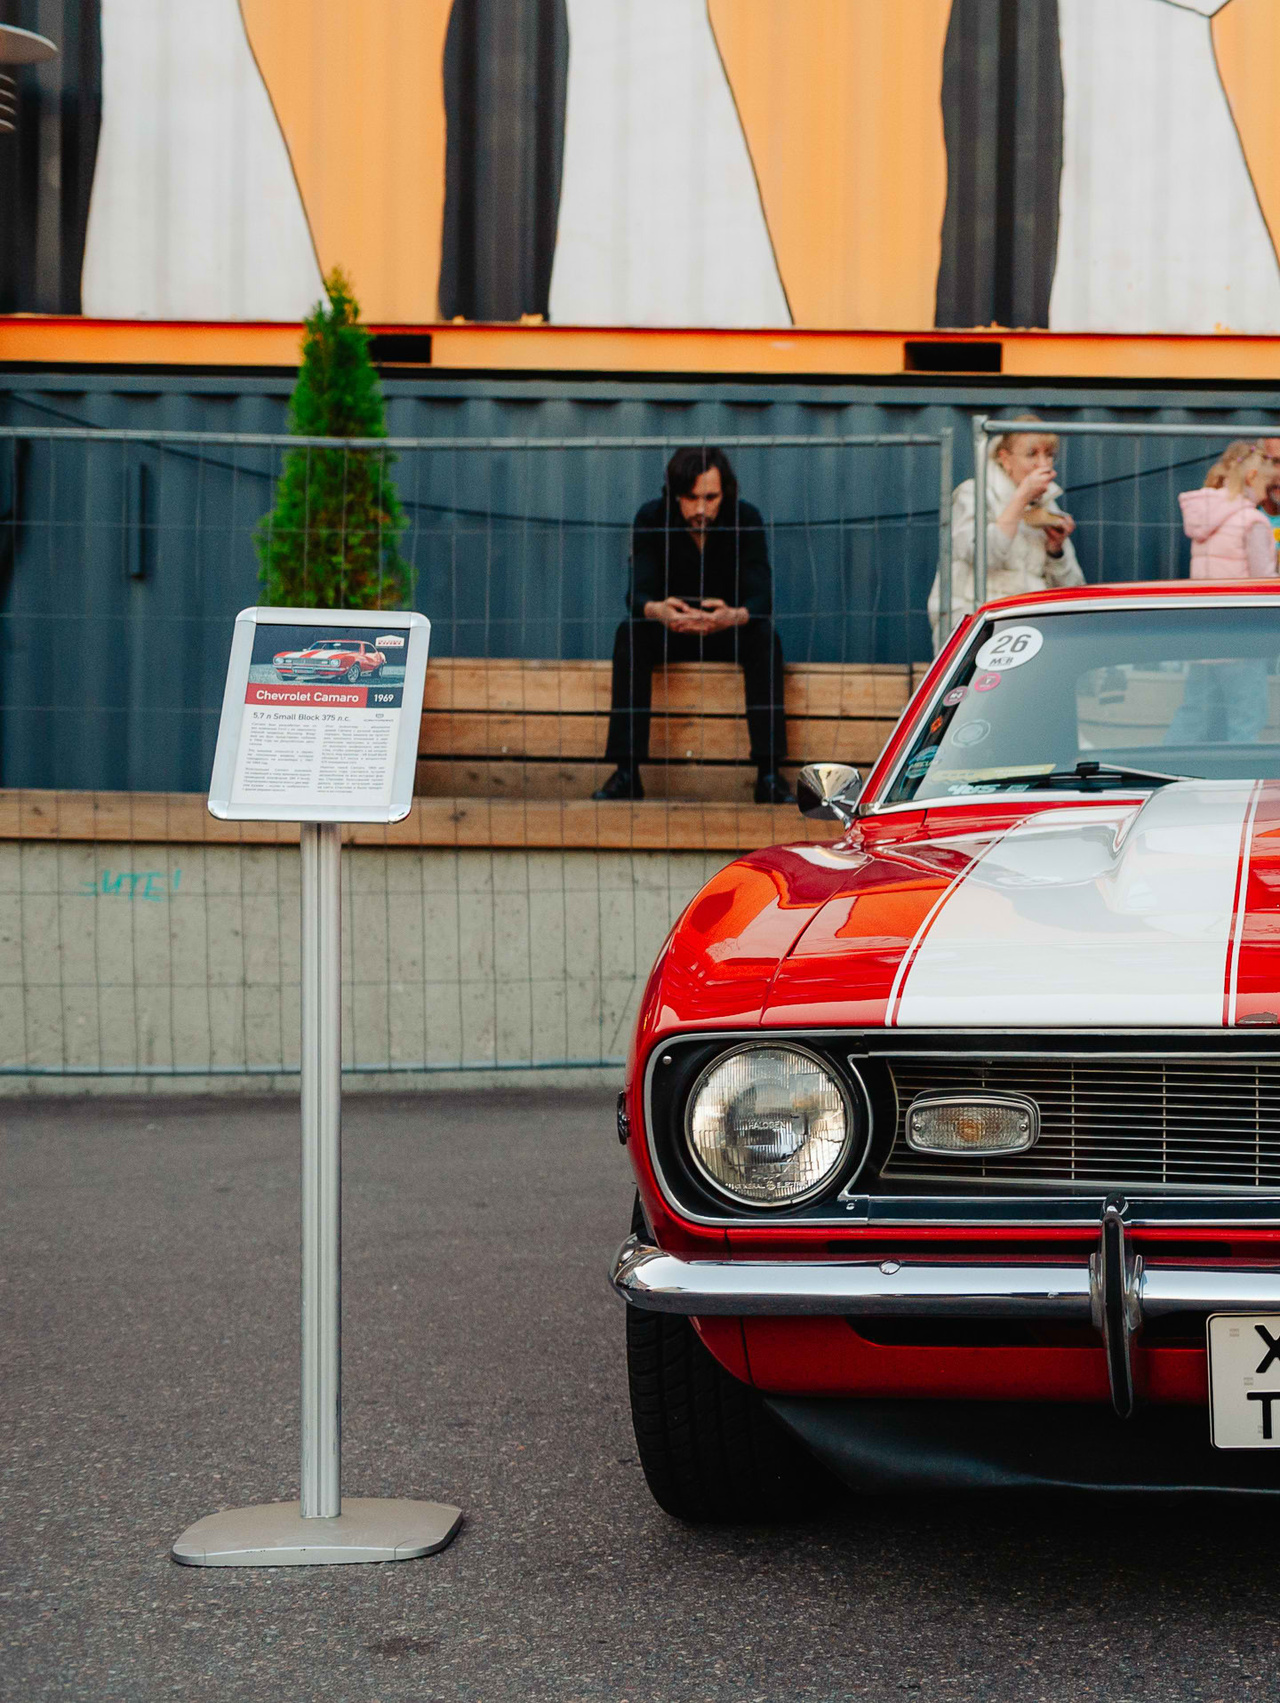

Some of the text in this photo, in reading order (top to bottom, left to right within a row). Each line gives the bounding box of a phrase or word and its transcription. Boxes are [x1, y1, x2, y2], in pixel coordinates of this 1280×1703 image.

[990, 634, 1032, 655] 26
[256, 690, 359, 702] Chevrolet Camaro
[374, 694, 394, 702] 1969
[273, 713, 296, 721] Small
[298, 713, 320, 721] Block
[321, 714, 336, 722] 375
[748, 1120, 786, 1130] HALOGEN
